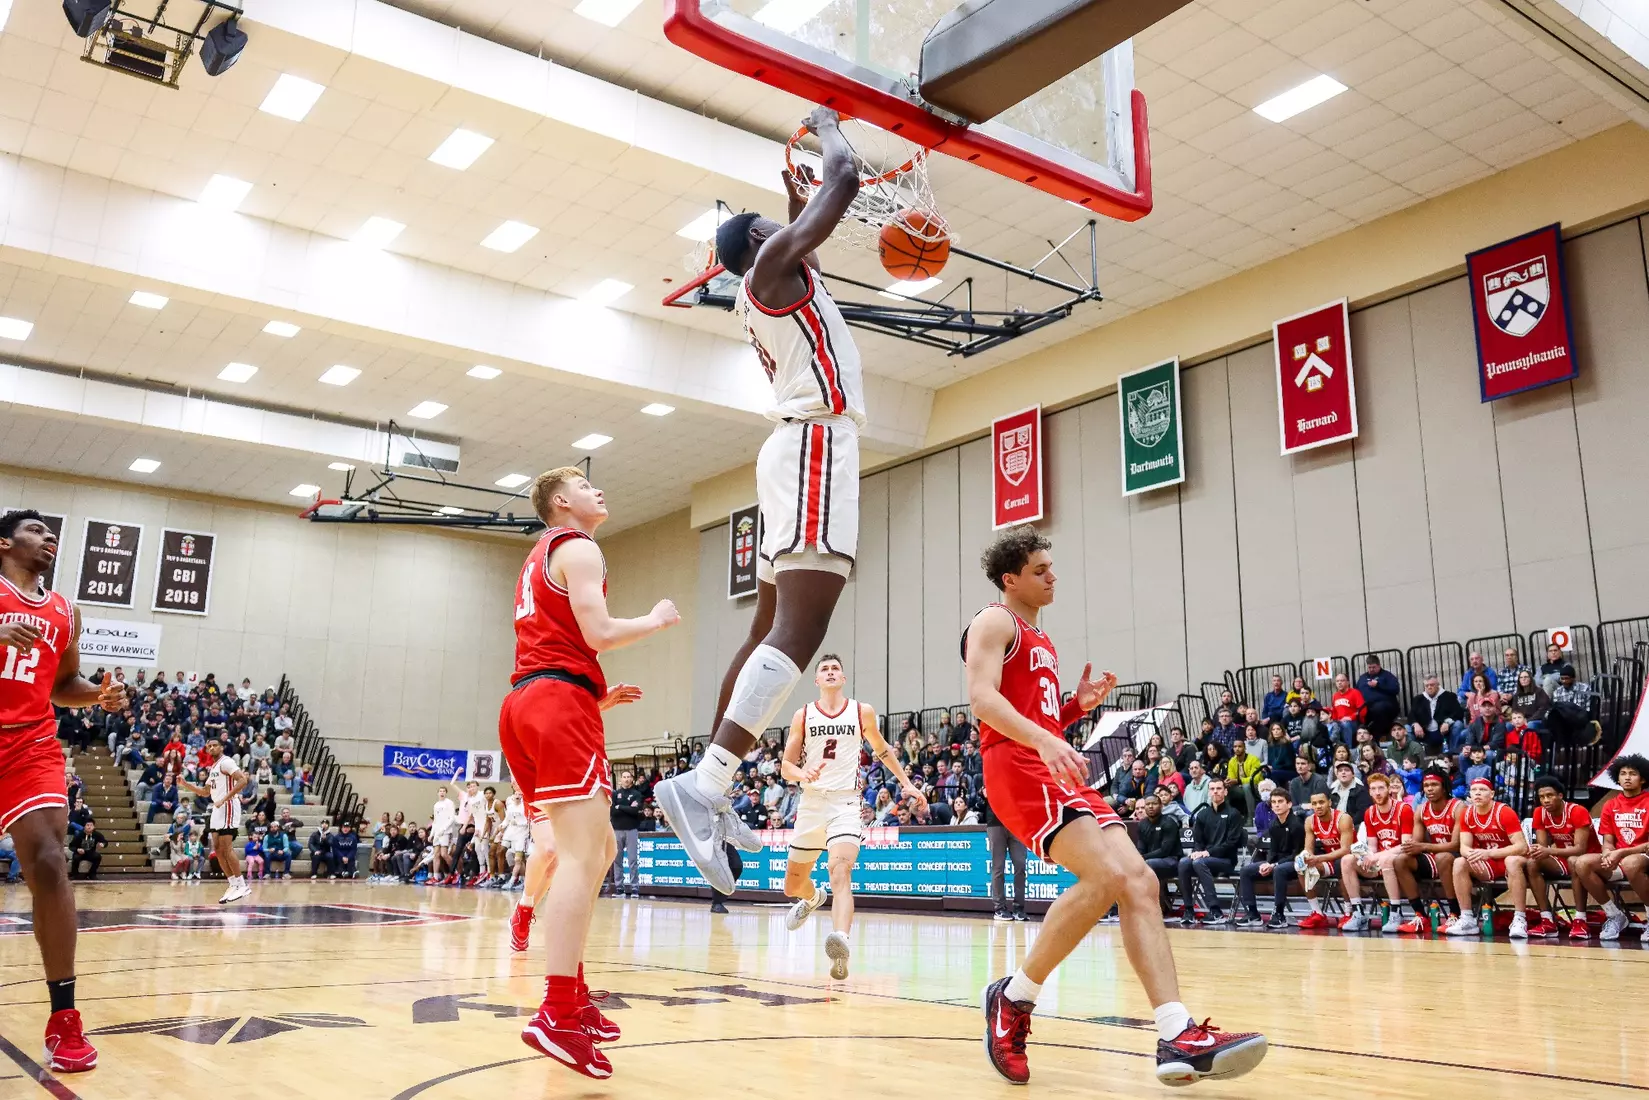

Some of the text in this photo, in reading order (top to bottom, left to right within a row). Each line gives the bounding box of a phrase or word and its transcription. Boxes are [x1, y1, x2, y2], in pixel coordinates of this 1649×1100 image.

[1486, 345, 1567, 379] Pennsylvania
[1297, 411, 1338, 433] Harvard
[1130, 453, 1174, 475] Dartmouth
[1004, 493, 1029, 510] Cornell
[98, 559, 121, 576] CIT
[173, 568, 196, 584] CBI
[87, 580, 123, 597] 2014
[165, 588, 199, 605] 2019
[86, 627, 138, 639] LEXUS
[1552, 631, 1569, 648] O
[96, 644, 109, 652] OF
[111, 645, 155, 656] WARWICK
[0, 645, 40, 684] 12
[1317, 660, 1329, 676] N
[809, 724, 856, 737] BROWN
[823, 739, 837, 760] 2
[392, 751, 456, 770] BayCoast
[473, 754, 494, 780] B
[437, 767, 455, 775] BANK
[917, 840, 971, 849] CONCERT TICKETS
[890, 862, 912, 870] TICKETS
[917, 862, 972, 871] CONCERT TICKETS
[1028, 860, 1058, 875] STORE
[890, 884, 912, 892] TICKETS
[917, 884, 972, 894] CONCERT TICKETS
[1028, 883, 1059, 899] STORE
